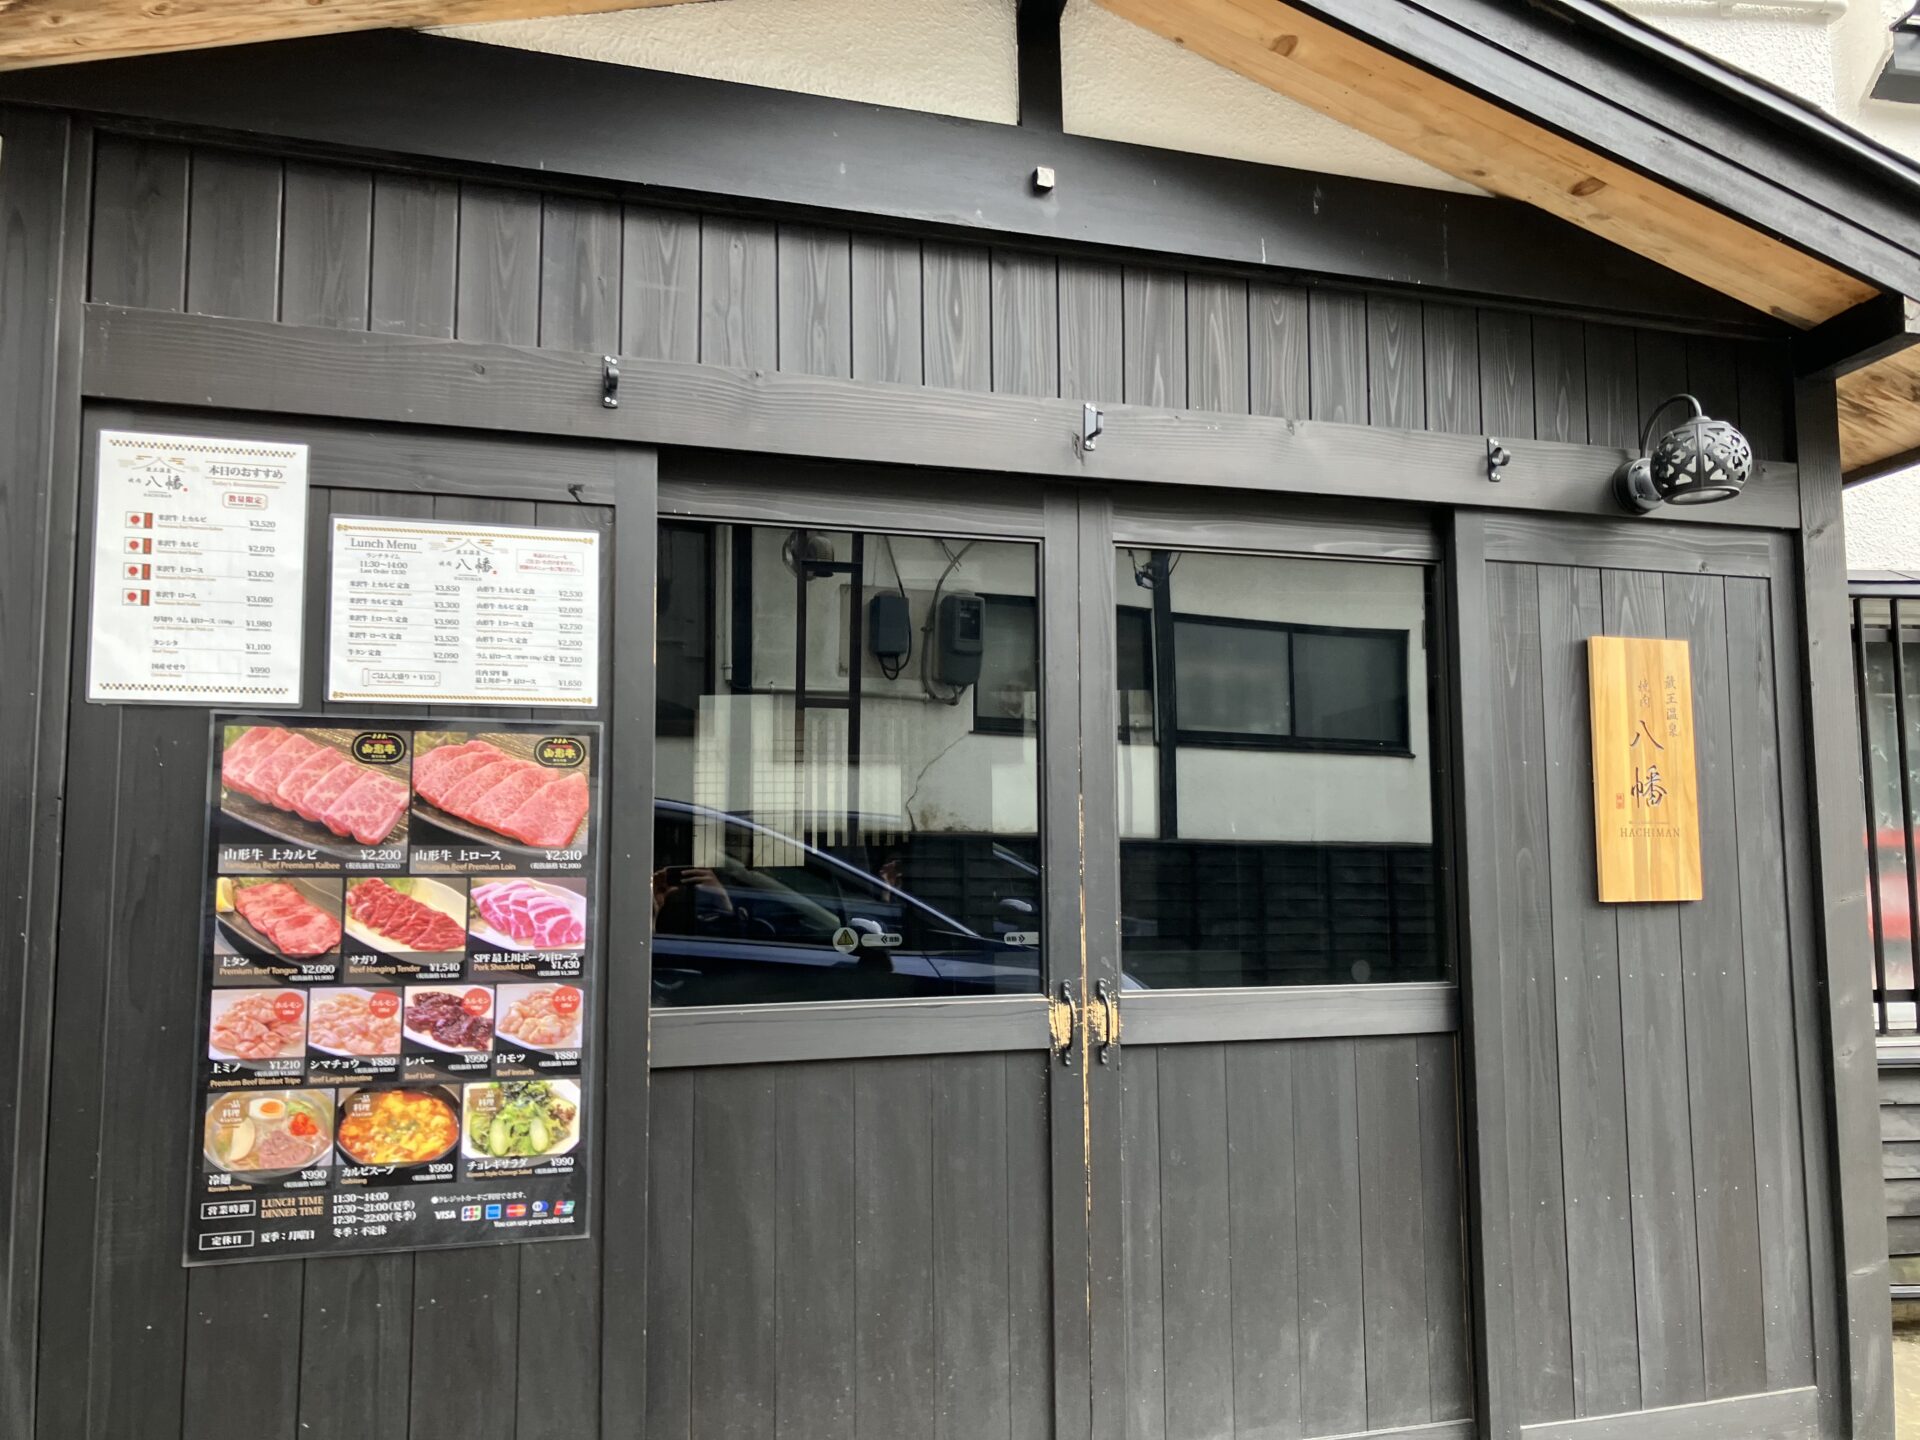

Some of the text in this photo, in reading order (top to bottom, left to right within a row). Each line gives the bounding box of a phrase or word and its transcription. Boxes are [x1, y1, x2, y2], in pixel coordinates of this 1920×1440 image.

[208, 464, 283, 479] 本日のおすすめ
[249, 520, 276, 528] ¥3,520
[248, 545, 275, 553] ¥2,970
[350, 538, 417, 550] Lunch Menu
[246, 620, 272, 628] ¥1,980
[246, 643, 272, 651] ¥1,100
[558, 639, 582, 647] ¥2,200
[434, 652, 459, 660] ¥2,090
[250, 666, 270, 674] ¥990
[1664, 675, 1678, 737] 蔵王温泉
[1630, 720, 1668, 808] 八幡
[1620, 828, 1680, 838] HACHIMAN
[224, 848, 402, 860] 山形牛 上カルビ ¥2,200
[415, 849, 582, 862] 山形牛 上ロース ¥2,310
[280, 862, 314, 870] Premium
[451, 862, 468, 870] Beef
[468, 862, 500, 870] Premium
[500, 862, 516, 870] Loin
[222, 956, 250, 967] 上タン
[350, 956, 378, 964] サガリ
[474, 954, 490, 963] SPF
[302, 964, 336, 974] ¥2,090
[366, 966, 396, 974] Hanging
[429, 963, 460, 972] ¥1,540
[551, 961, 580, 970] ¥1,430
[219, 968, 252, 976] Premium
[272, 968, 298, 976] Tongue
[405, 1054, 488, 1066] レバー ¥990
[496, 1051, 578, 1064] 白モツ ¥880
[211, 1060, 300, 1074] 上ミノ ¥1,210
[310, 1058, 396, 1070] シマチョウ ¥880
[420, 1072, 436, 1080] Liver
[210, 1078, 301, 1088] Premium Beef Blanket Tripe
[467, 1158, 574, 1170] チョレギサラダ ¥990
[342, 1164, 454, 1177] カルビスープ ¥990
[208, 1170, 327, 1186] 冷麺 ¥990
[262, 1196, 324, 1208] LUNCH TIME
[207, 1204, 250, 1216] 営業時間
[261, 1206, 324, 1219] DINNER TIME
[434, 1210, 456, 1220] VISA
[211, 1235, 242, 1246] 定休日
